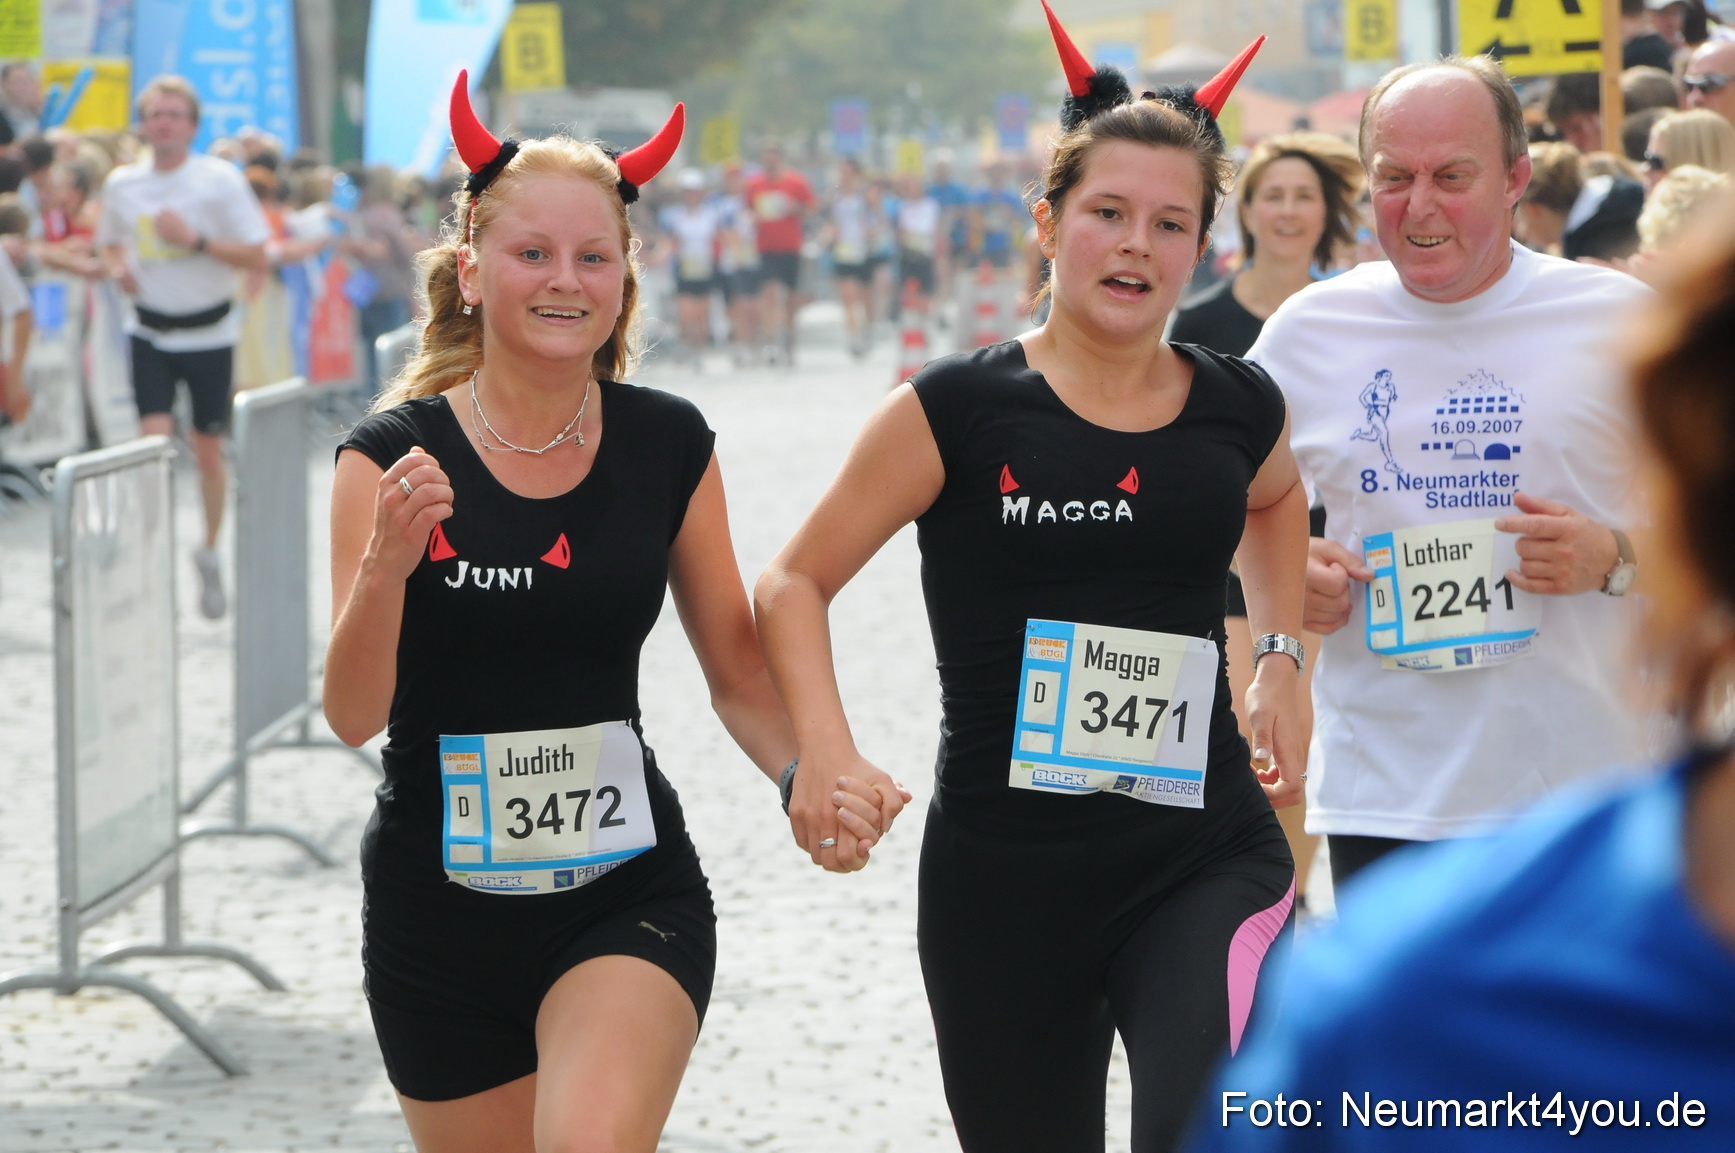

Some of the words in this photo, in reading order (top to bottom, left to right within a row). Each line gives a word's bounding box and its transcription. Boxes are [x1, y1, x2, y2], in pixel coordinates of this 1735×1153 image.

[1358, 3, 1387, 45] B
[1431, 420, 1523, 434] 16.09.2007
[1360, 469, 1389, 493] 8.
[1397, 471, 1520, 491] Neumarkter
[1002, 496, 1133, 525] MAGGA
[1404, 538, 1473, 567] Lothar
[445, 561, 532, 591] JUNI
[1376, 589, 1385, 608] D
[1411, 575, 1514, 621] 2241
[1083, 639, 1160, 681] Magga
[1033, 681, 1046, 704] D
[1080, 690, 1188, 743] 3471
[499, 743, 575, 777] Judith
[1032, 769, 1087, 785] BOCK
[1137, 776, 1200, 796] PFLEIDERER
[458, 796, 470, 818] D
[505, 785, 626, 840] 3472
[468, 876, 522, 886] BOCK
